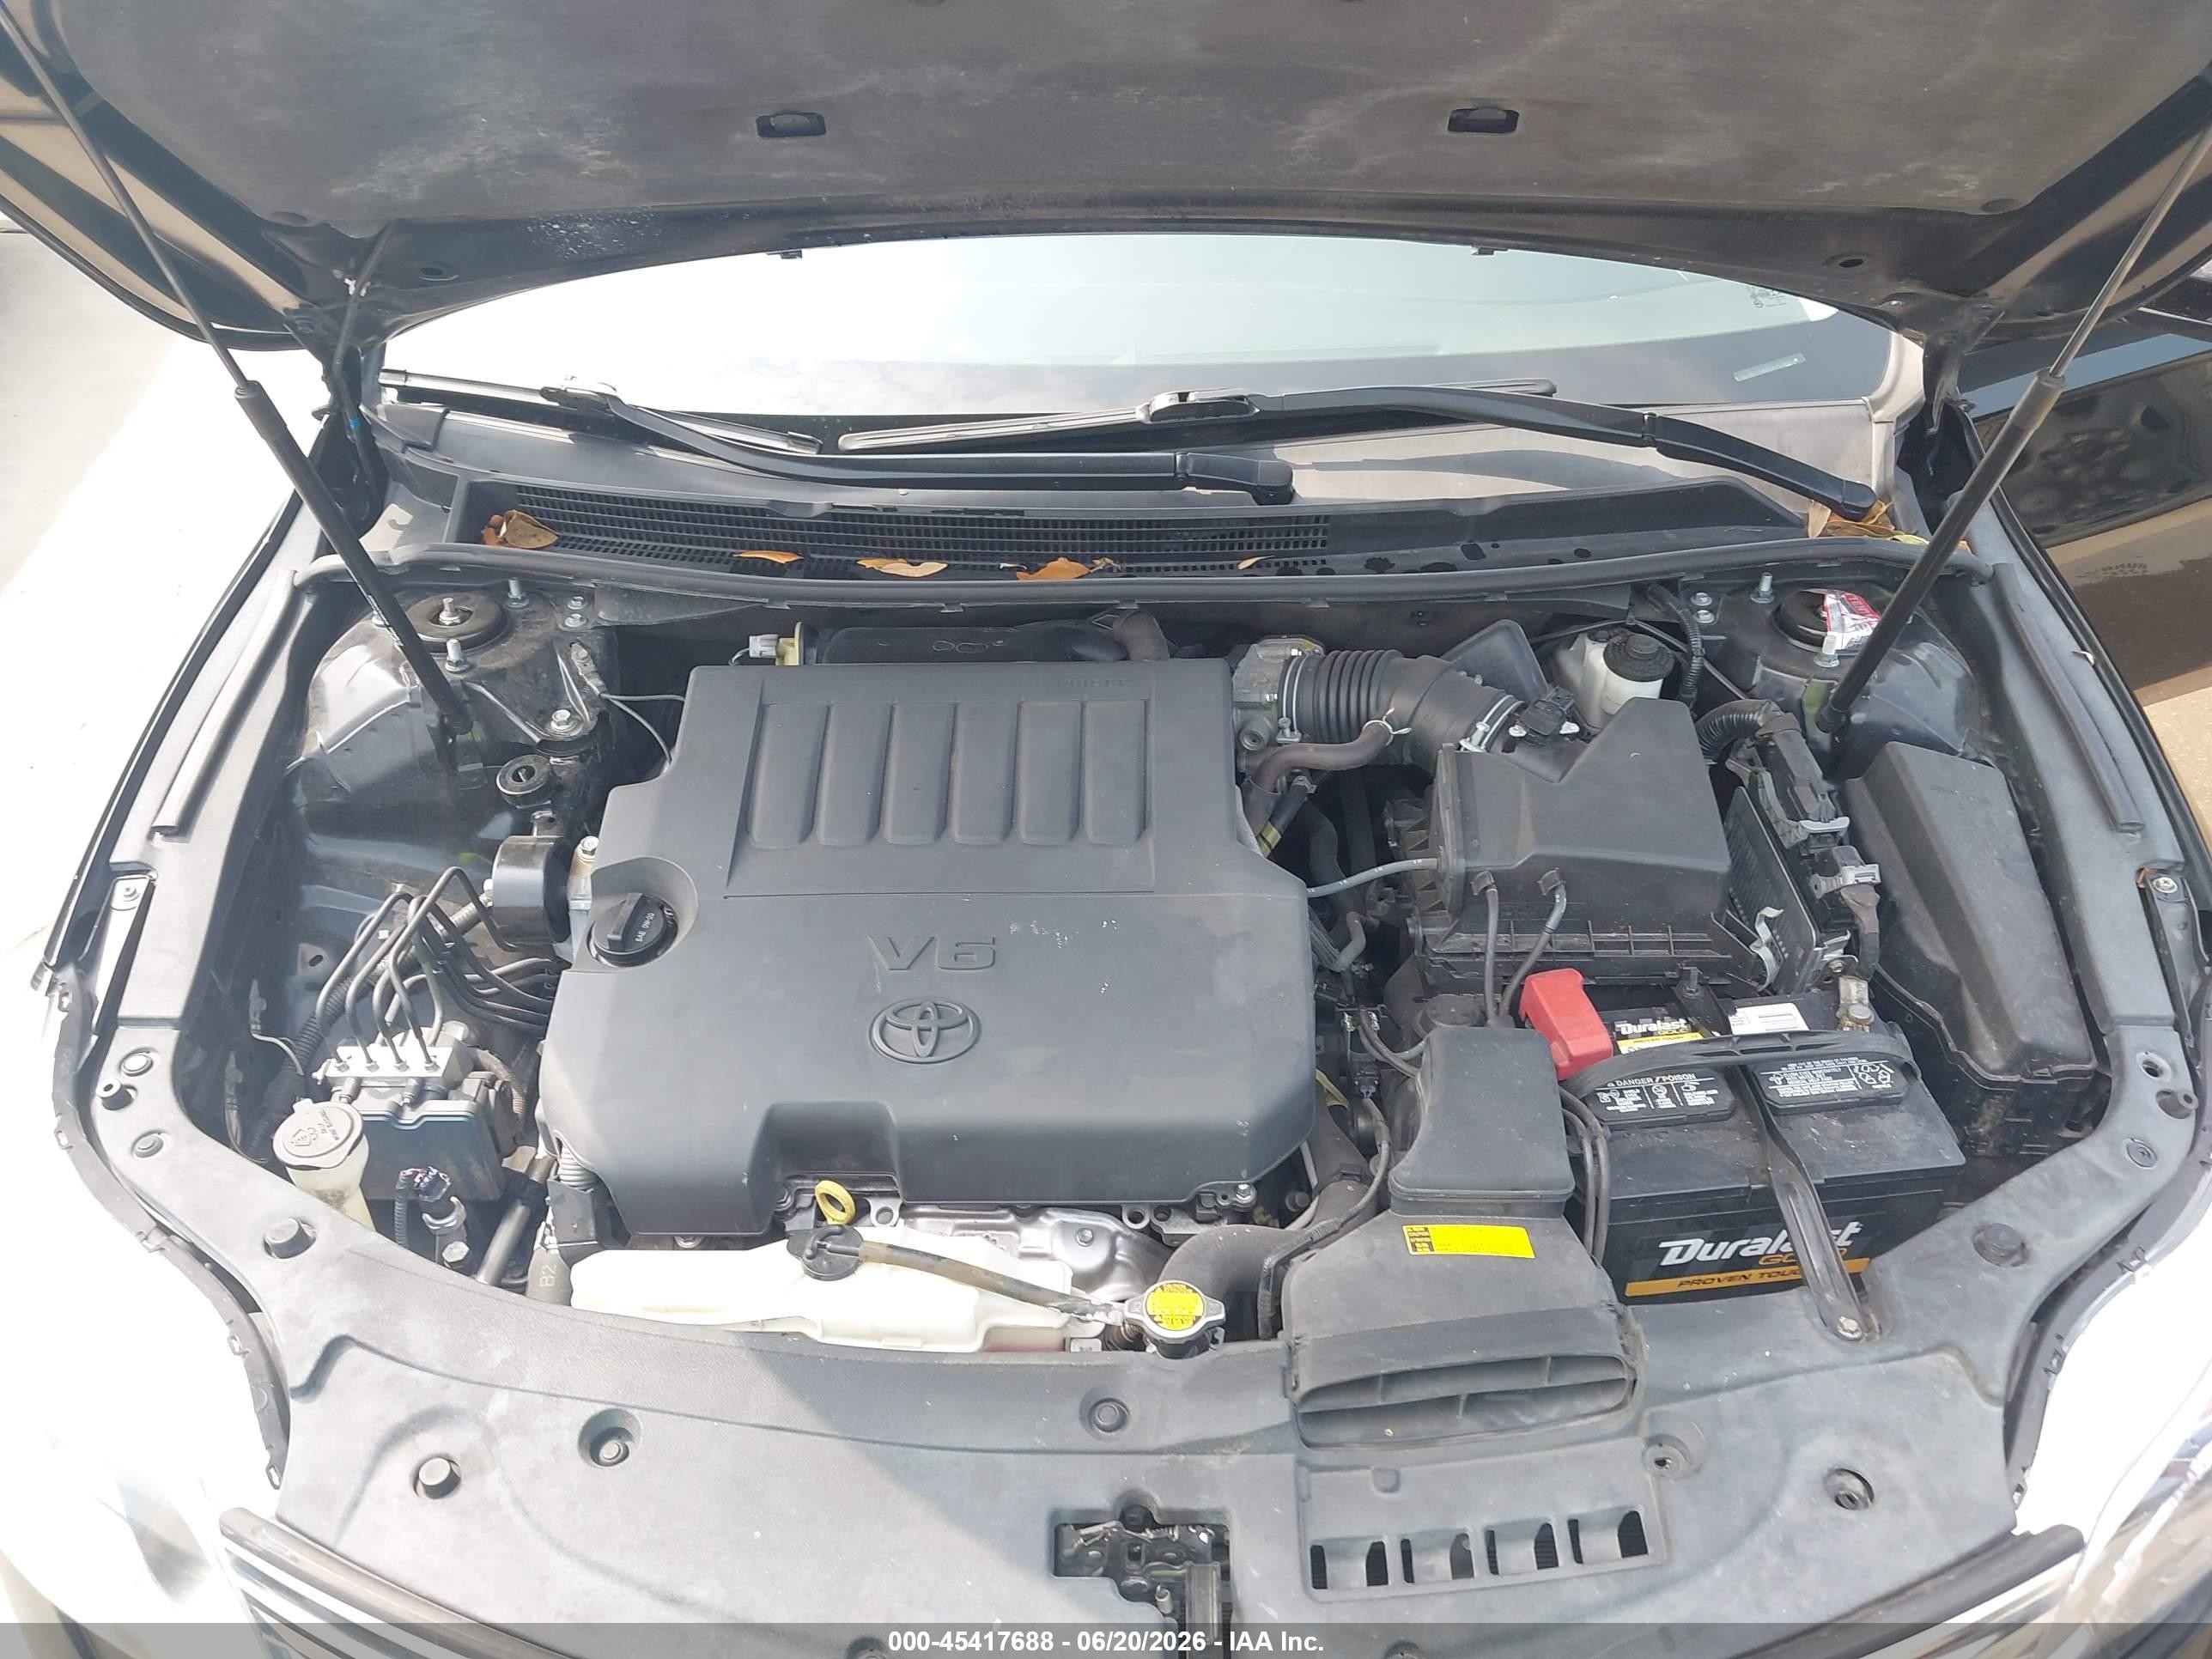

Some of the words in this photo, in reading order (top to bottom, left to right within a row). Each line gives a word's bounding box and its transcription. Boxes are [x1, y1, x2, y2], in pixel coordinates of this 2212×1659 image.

[867, 935, 997, 972] V6
[1614, 1018, 1688, 1036] Duralast
[1657, 1221, 1864, 1267] Duralt
[539, 1264, 557, 1287] B2
[1677, 1273, 1753, 1288] PROVEN
